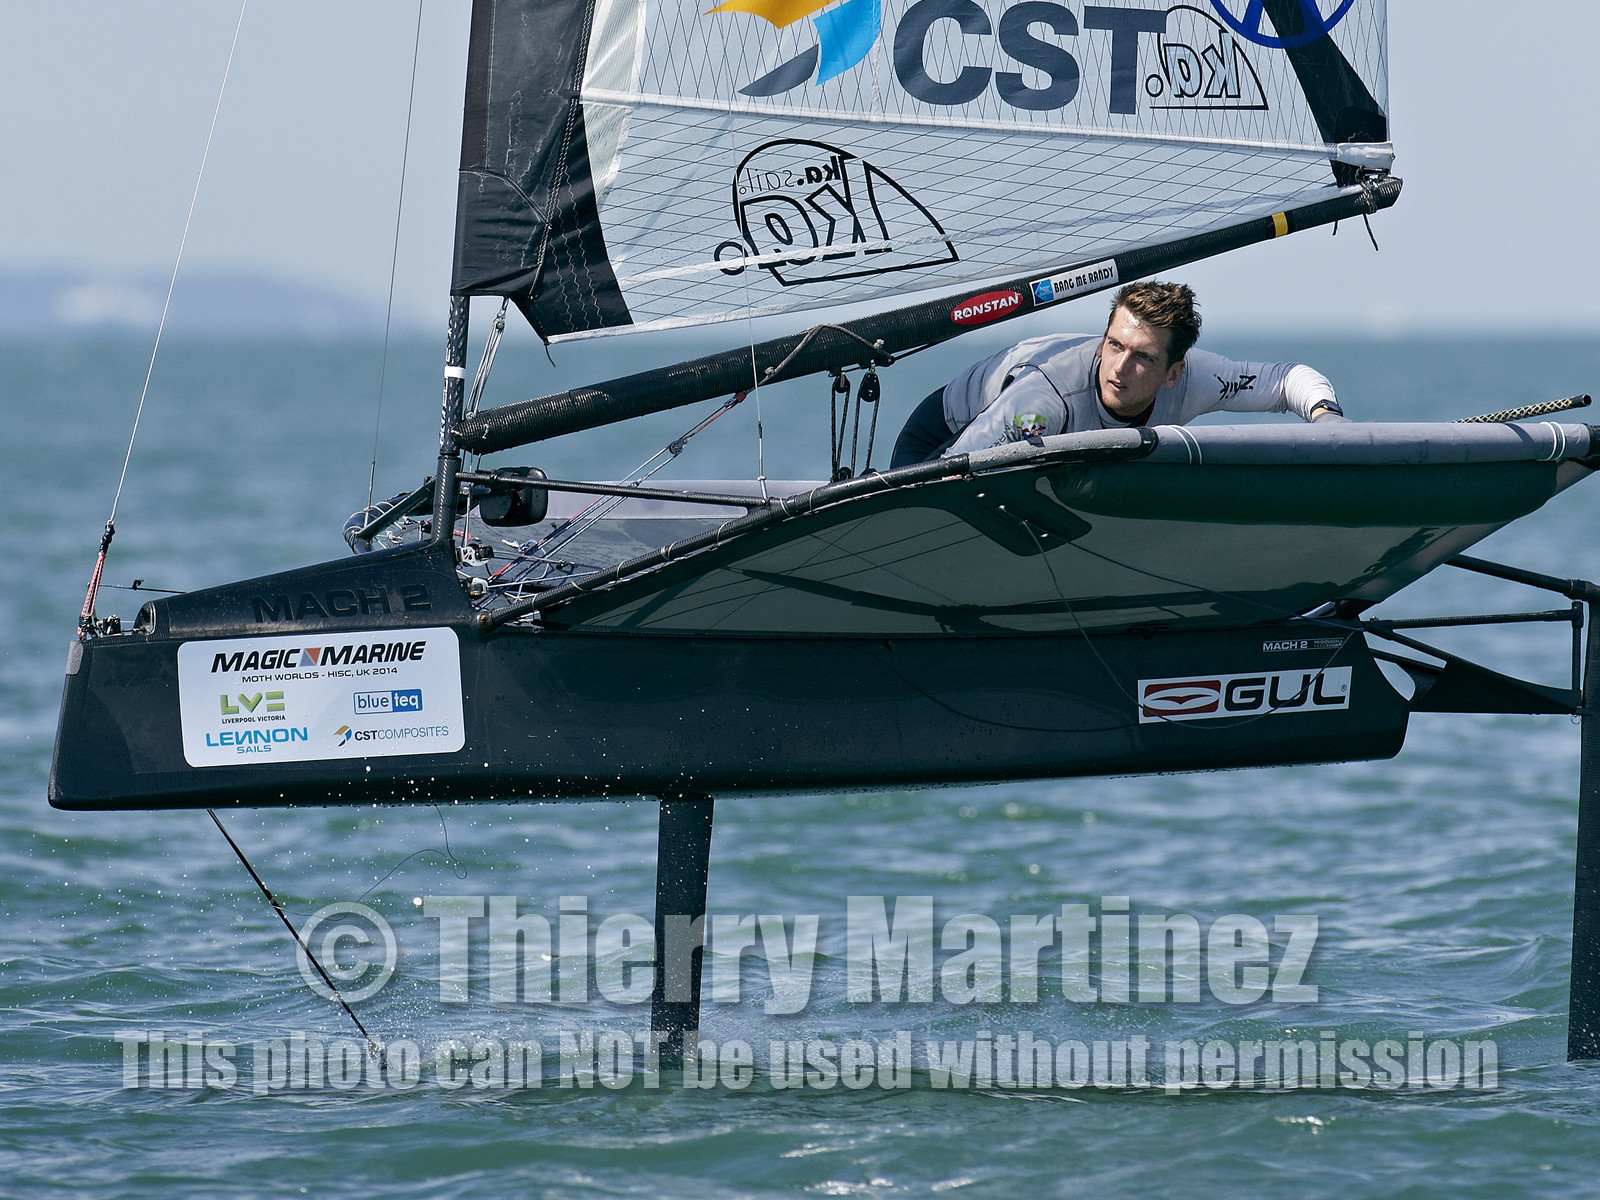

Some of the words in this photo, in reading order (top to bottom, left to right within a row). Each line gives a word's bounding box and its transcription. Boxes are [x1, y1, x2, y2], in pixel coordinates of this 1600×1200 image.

[1053, 277, 1075, 293] BANG
[1075, 273, 1088, 287] ME
[1088, 266, 1114, 284] RANDY
[954, 295, 1019, 320] RONSTAN
[251, 586, 392, 622] MACH
[401, 584, 432, 611] 2
[211, 649, 300, 673] MAGIC
[320, 641, 426, 666] MARINE
[1263, 641, 1298, 651] MACH
[1300, 640, 1309, 649] 2
[242, 673, 272, 683] MOTH
[275, 671, 320, 681] WORLDS
[327, 669, 354, 678] HISC,
[356, 668, 371, 676] UK
[373, 667, 398, 675] 2014
[1224, 673, 1348, 712] GUL
[206, 727, 308, 747] LENNON
[237, 745, 272, 754] SAILS
